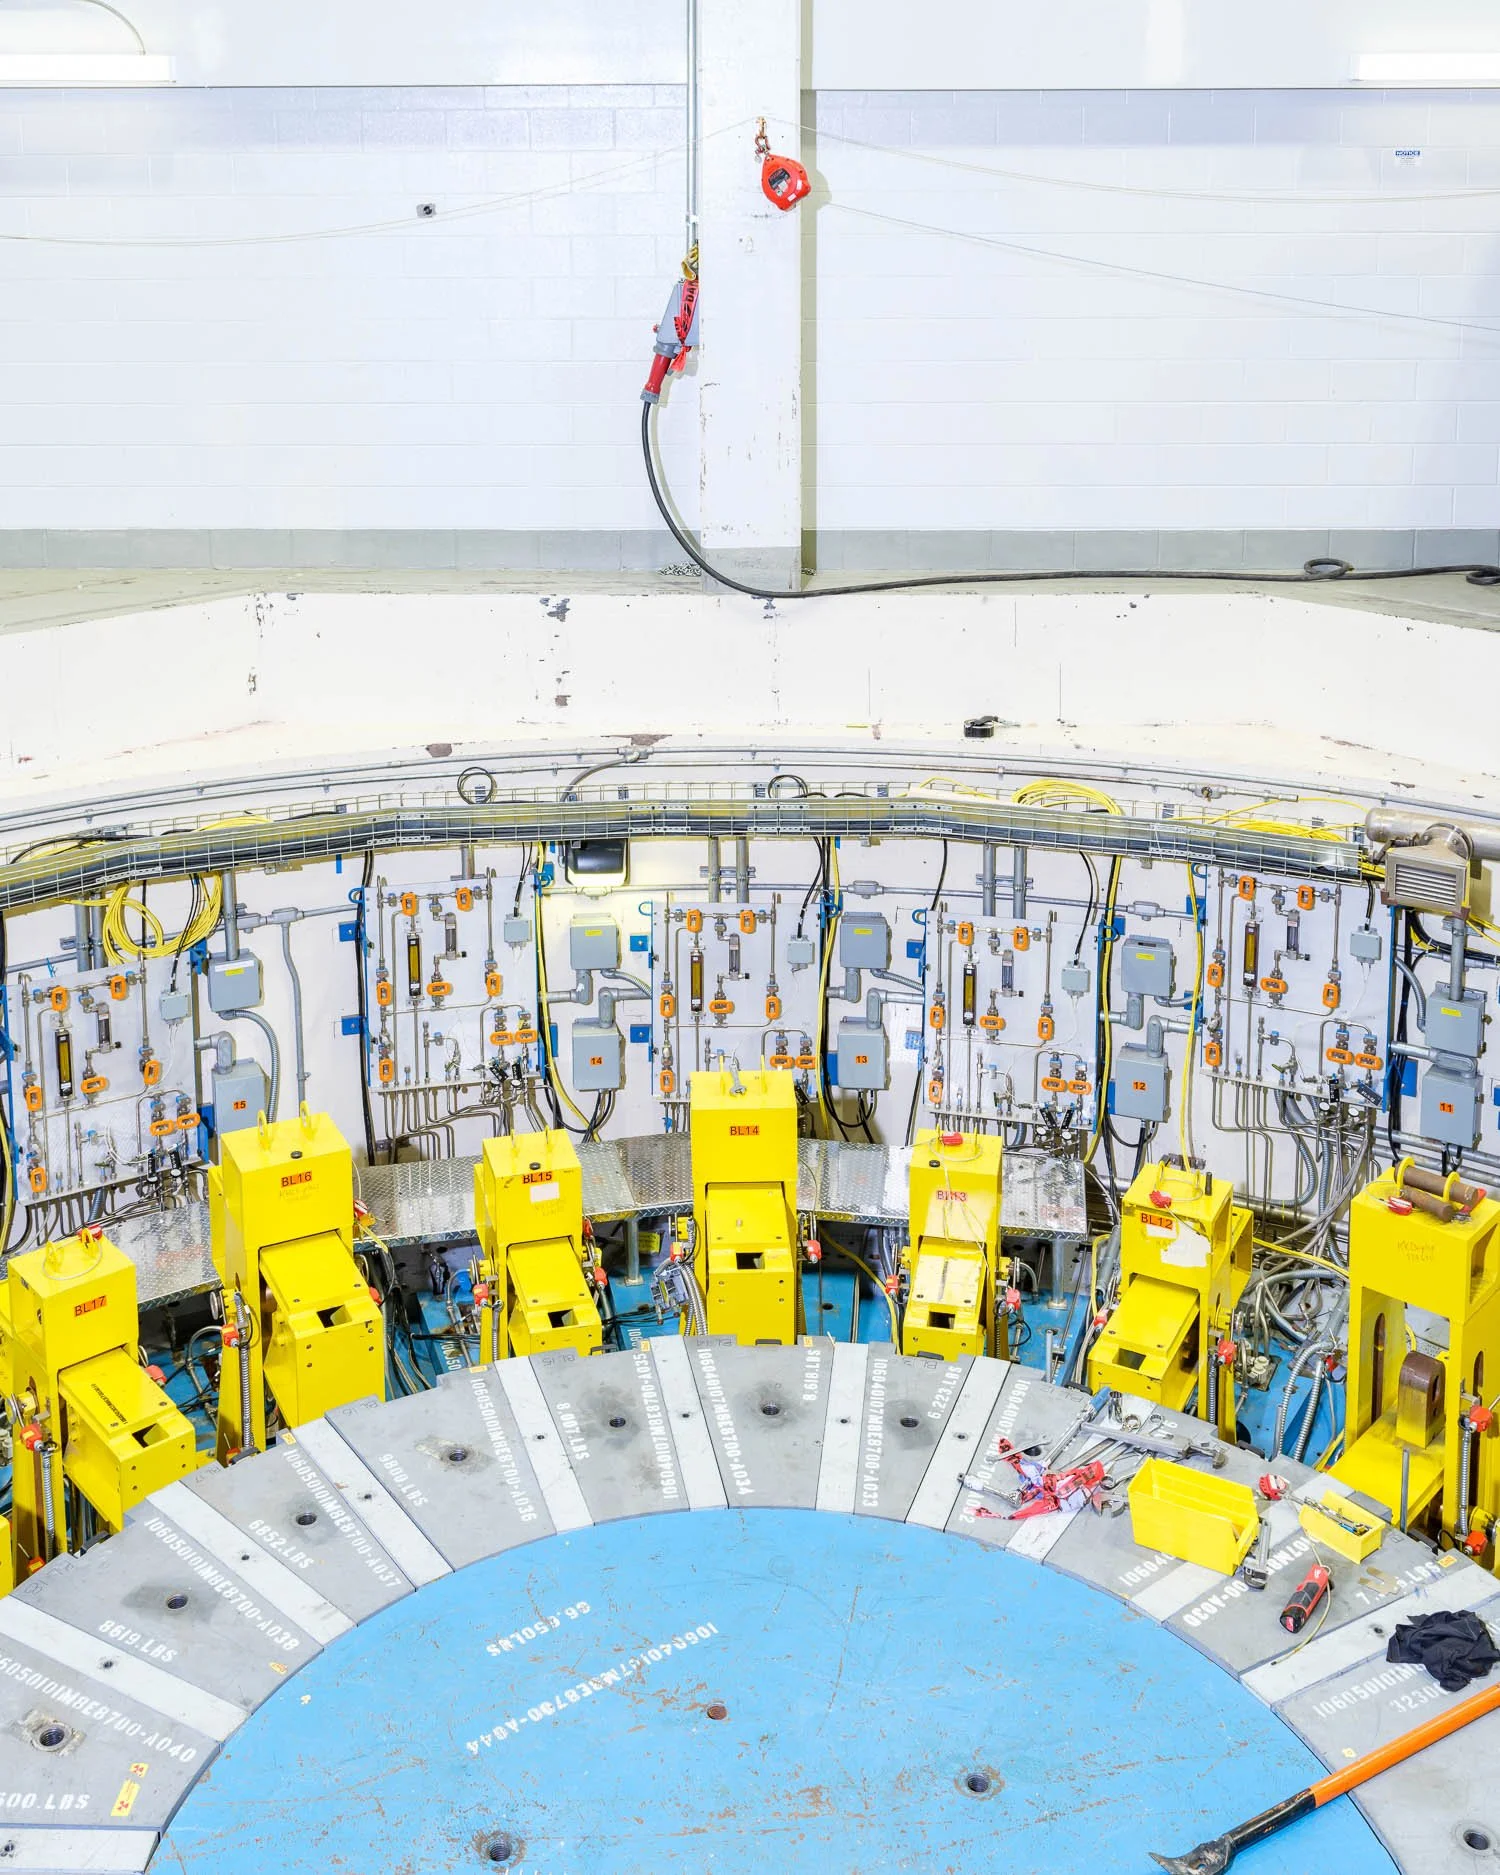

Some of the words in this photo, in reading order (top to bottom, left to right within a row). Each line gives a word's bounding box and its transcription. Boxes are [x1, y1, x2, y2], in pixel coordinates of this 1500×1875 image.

[591, 1057, 602, 1065] 14
[856, 1055, 867, 1063] 13
[1133, 1081, 1146, 1090] 12
[234, 1101, 246, 1110] 15
[1440, 1102, 1453, 1112] 11
[729, 1125, 759, 1136] BL14
[281, 1171, 312, 1187] BL16
[523, 1171, 552, 1184] BL15
[1141, 1212, 1173, 1230] BL12
[75, 1295, 106, 1317] BL17
[929, 1366, 963, 1420] 6.223.LBS
[556, 1403, 590, 1461] 8.007.LBS
[380, 1454, 428, 1507] 9800.LBS
[248, 1520, 313, 1569] 6852.LBS
[99, 1620, 176, 1662] 8619.LBS
